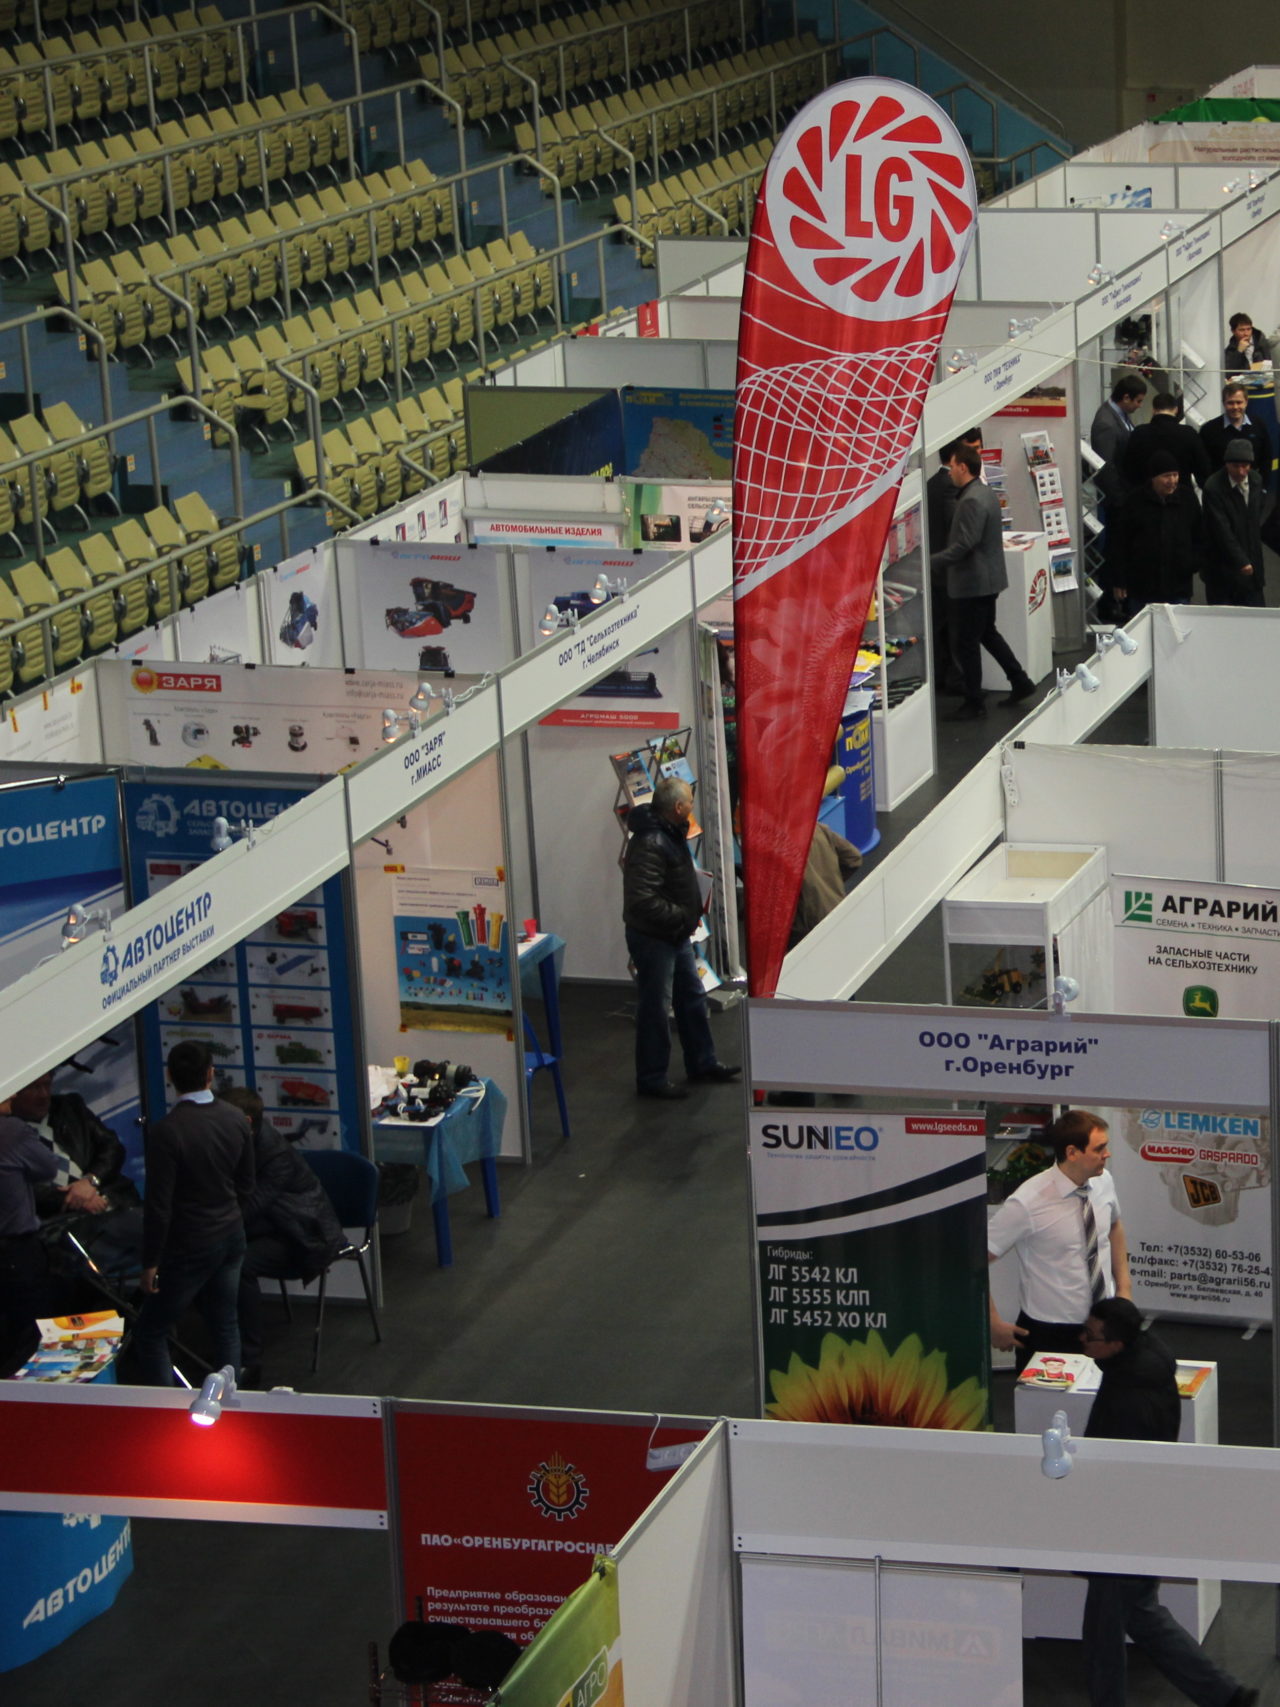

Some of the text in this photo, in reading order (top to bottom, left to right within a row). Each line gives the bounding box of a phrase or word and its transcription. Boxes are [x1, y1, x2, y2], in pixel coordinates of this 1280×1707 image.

[845, 154, 914, 243] LG
[490, 523, 603, 537] АВТОМОБИЛЬНЫЕ ИЗДЕЛИЯ
[558, 604, 640, 666] ООО "ТД "Сельхозтехника"
[582, 639, 620, 669] г.Челябинск
[162, 676, 217, 690] ЗАРЯ
[404, 731, 446, 769] ООО "ЗАРЯ"
[411, 754, 442, 785] г.МИАСС
[0, 814, 106, 848] ТОЦЕНТР
[1161, 895, 1278, 923] АГРАРИЙ
[122, 892, 212, 973] АВТОЦЕНТР
[1155, 918, 1188, 929] СЕМЕНА
[1197, 923, 1233, 933] ТЕХНИКА
[1155, 945, 1250, 963] ЗАПАСНЫЕ ЧАСТИ
[103, 924, 215, 1010] ОФИЦИАЛЬНЫЙ ПАРТНЕР ВЫСТАВКИ
[1148, 956, 1258, 975] НА СЕЛЬХОЗТЕХНИКУ
[919, 1031, 1100, 1057] ООО "Аграрий"
[945, 1057, 1075, 1080] г.Оренбург
[1164, 1111, 1259, 1137] LEMKEN
[762, 1121, 978, 1152] SUNEO www.lgseeds.ru
[1147, 1145, 1258, 1166] MASCHIO GASPARDO
[1190, 1179, 1219, 1204] JCB
[767, 1245, 814, 1260] Гибриды:
[1139, 1242, 1261, 1263] Тел: +7(3532) 60-53-06
[768, 1264, 858, 1284] ЛГ 5542 КЛ
[1129, 1268, 1271, 1289] e-mail: parts@agrarii56.ru
[1182, 1259, 1228, 1274] +7(3532)
[1231, 1263, 1272, 1277] 76-25-4
[1144, 1279, 1182, 1290] Оренбург,
[769, 1286, 870, 1306] ЛГ 5555 КЛП
[770, 1308, 887, 1328] ЛГ 5452 ХО КЛ
[24, 1518, 132, 1630] АВТОЦЕНТ
[427, 1586, 501, 1600] Предприятие
[428, 1602, 490, 1614] результате
[429, 1615, 531, 1628] существовавшего
[577, 1662, 607, 1707] АГРО
